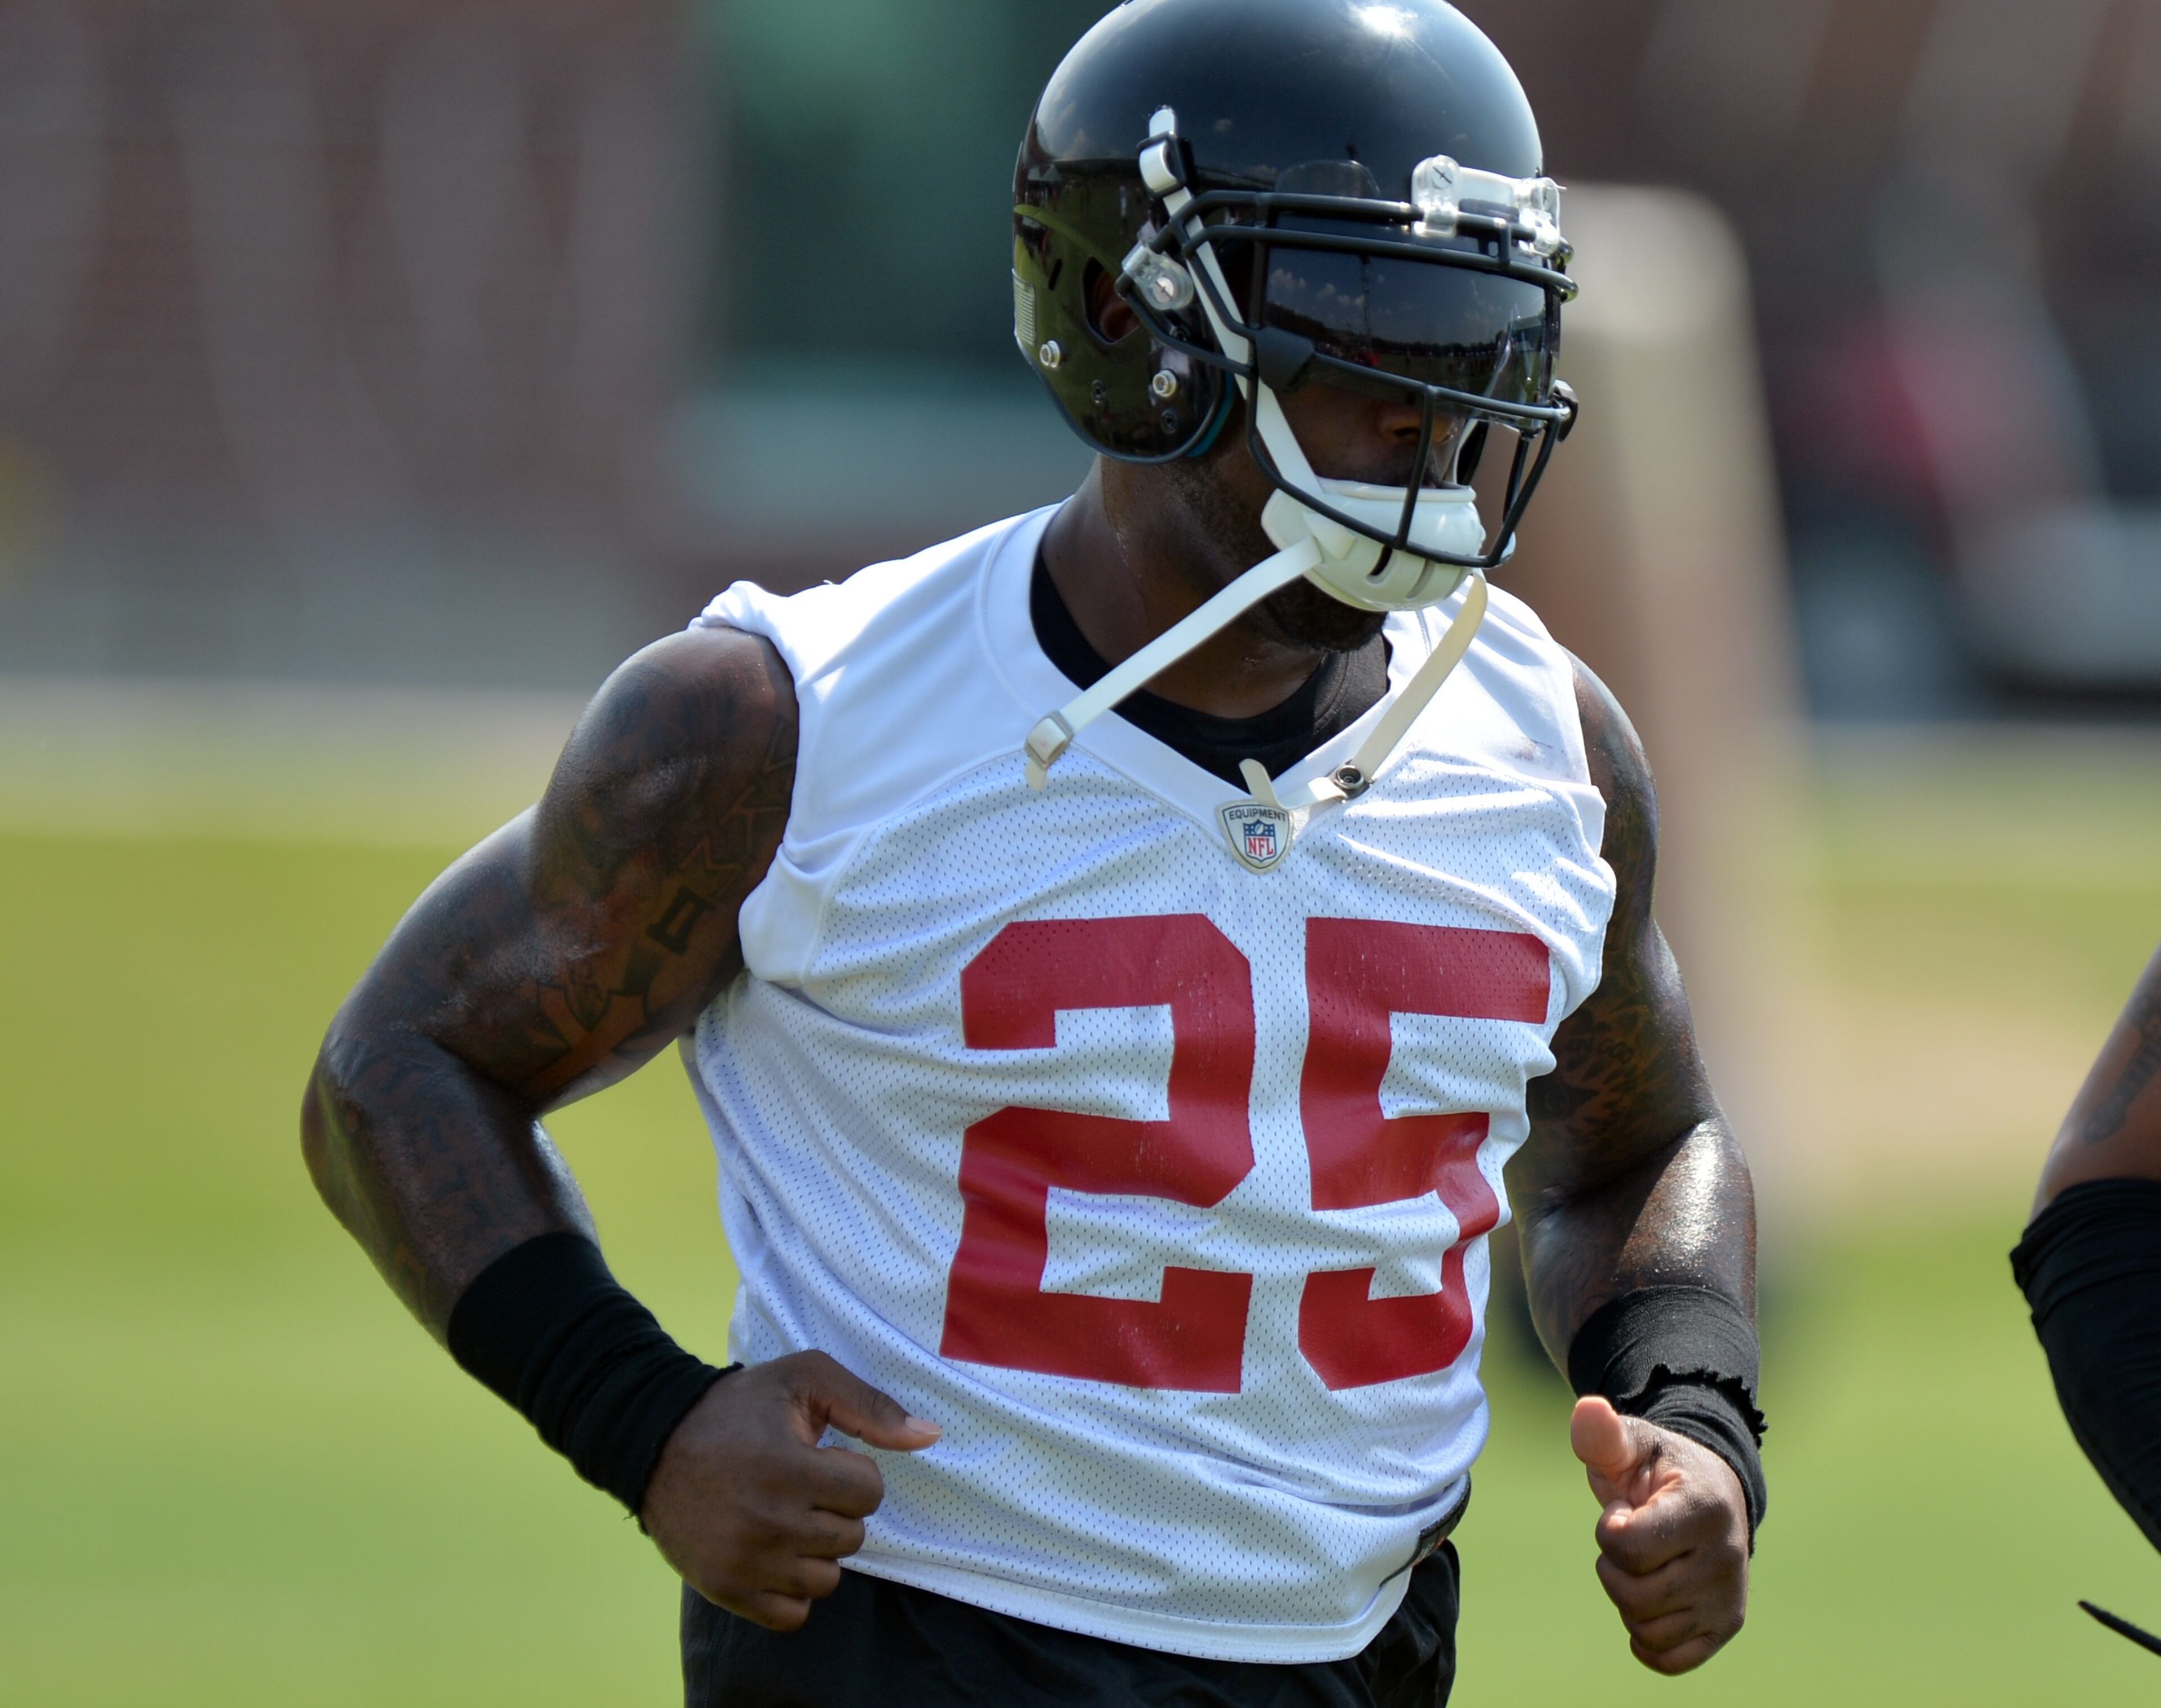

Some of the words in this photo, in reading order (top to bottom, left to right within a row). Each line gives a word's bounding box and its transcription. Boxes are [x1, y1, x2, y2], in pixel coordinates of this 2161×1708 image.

[1229, 808, 1286, 822] EQUIPMENT
[1248, 837, 1274, 857] NFL
[939, 913, 1550, 1394] 25
